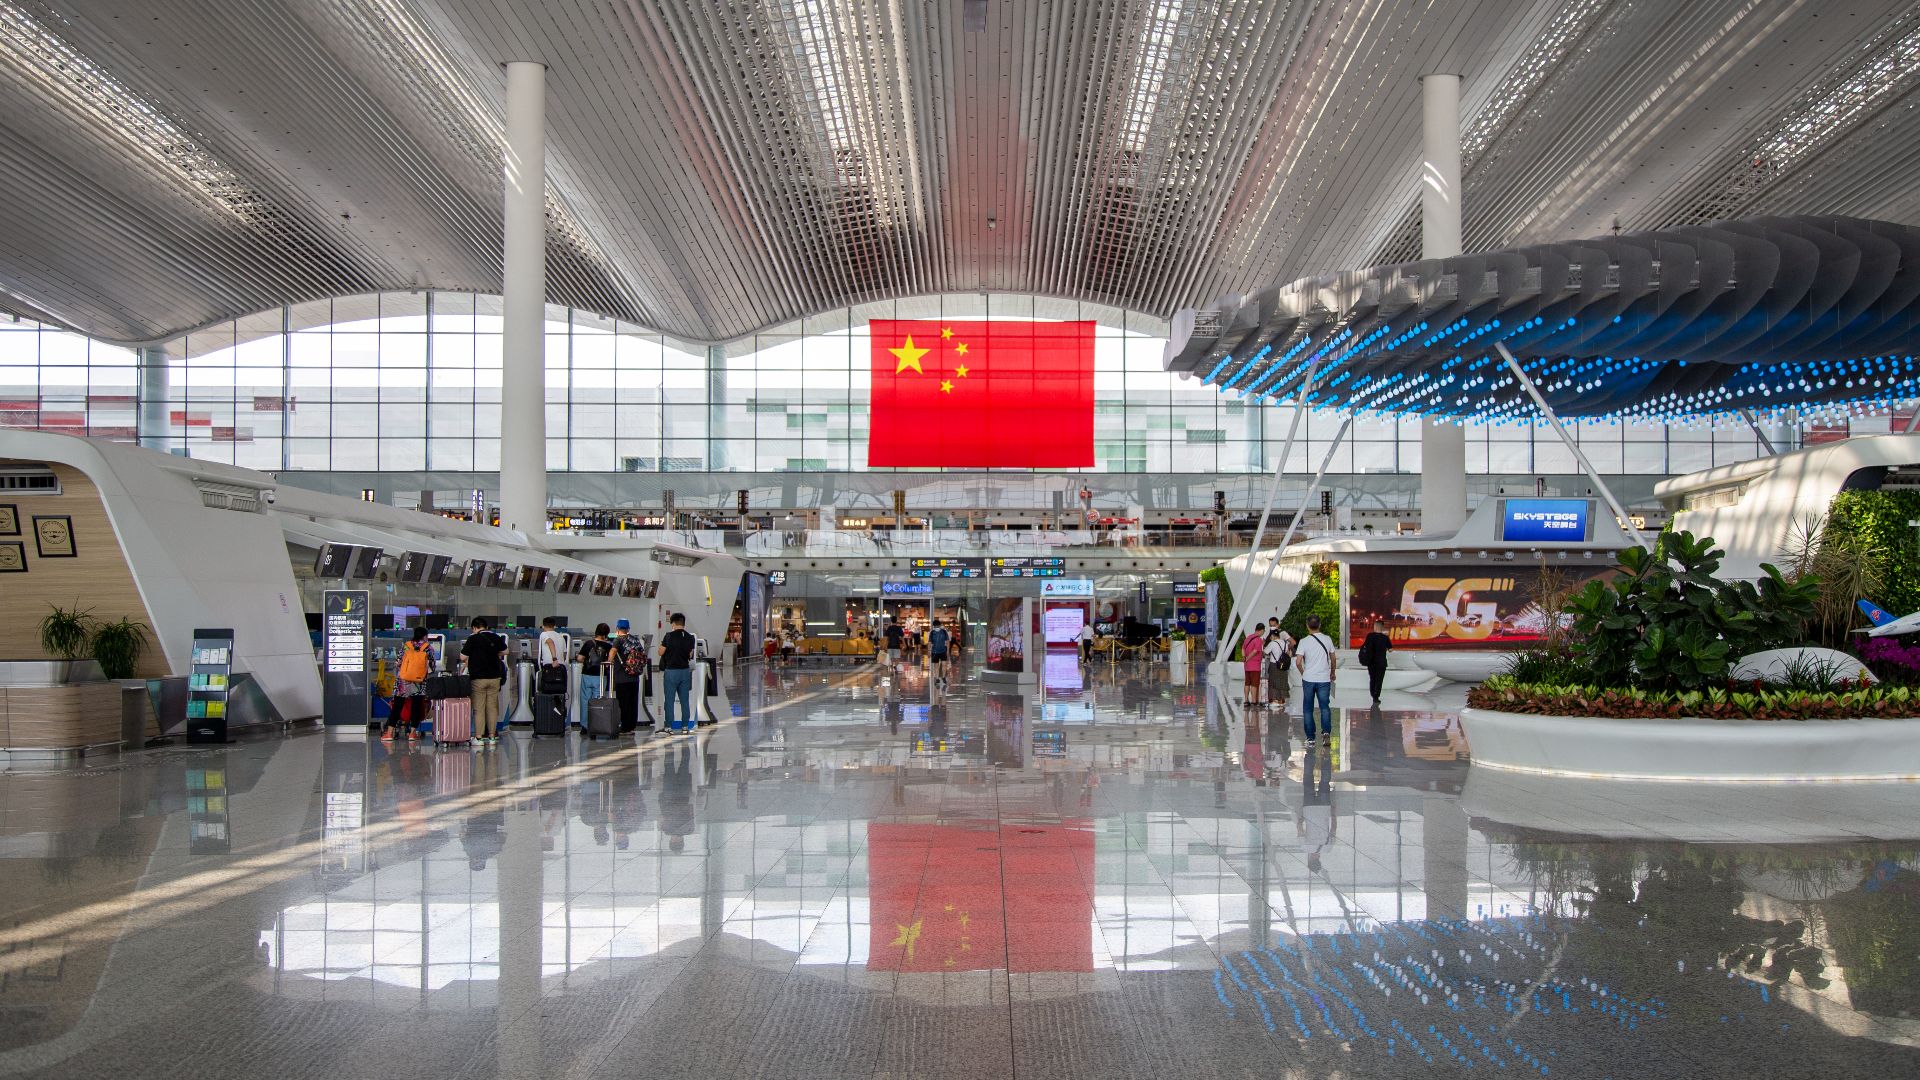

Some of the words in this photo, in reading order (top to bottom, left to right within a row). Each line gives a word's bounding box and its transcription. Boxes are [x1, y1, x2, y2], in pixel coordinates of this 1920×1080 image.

[1513, 512, 1578, 521] SKYSTAGE
[892, 583, 931, 593] Columbia
[342, 597, 352, 612] J
[1400, 577, 1498, 640] 5G
